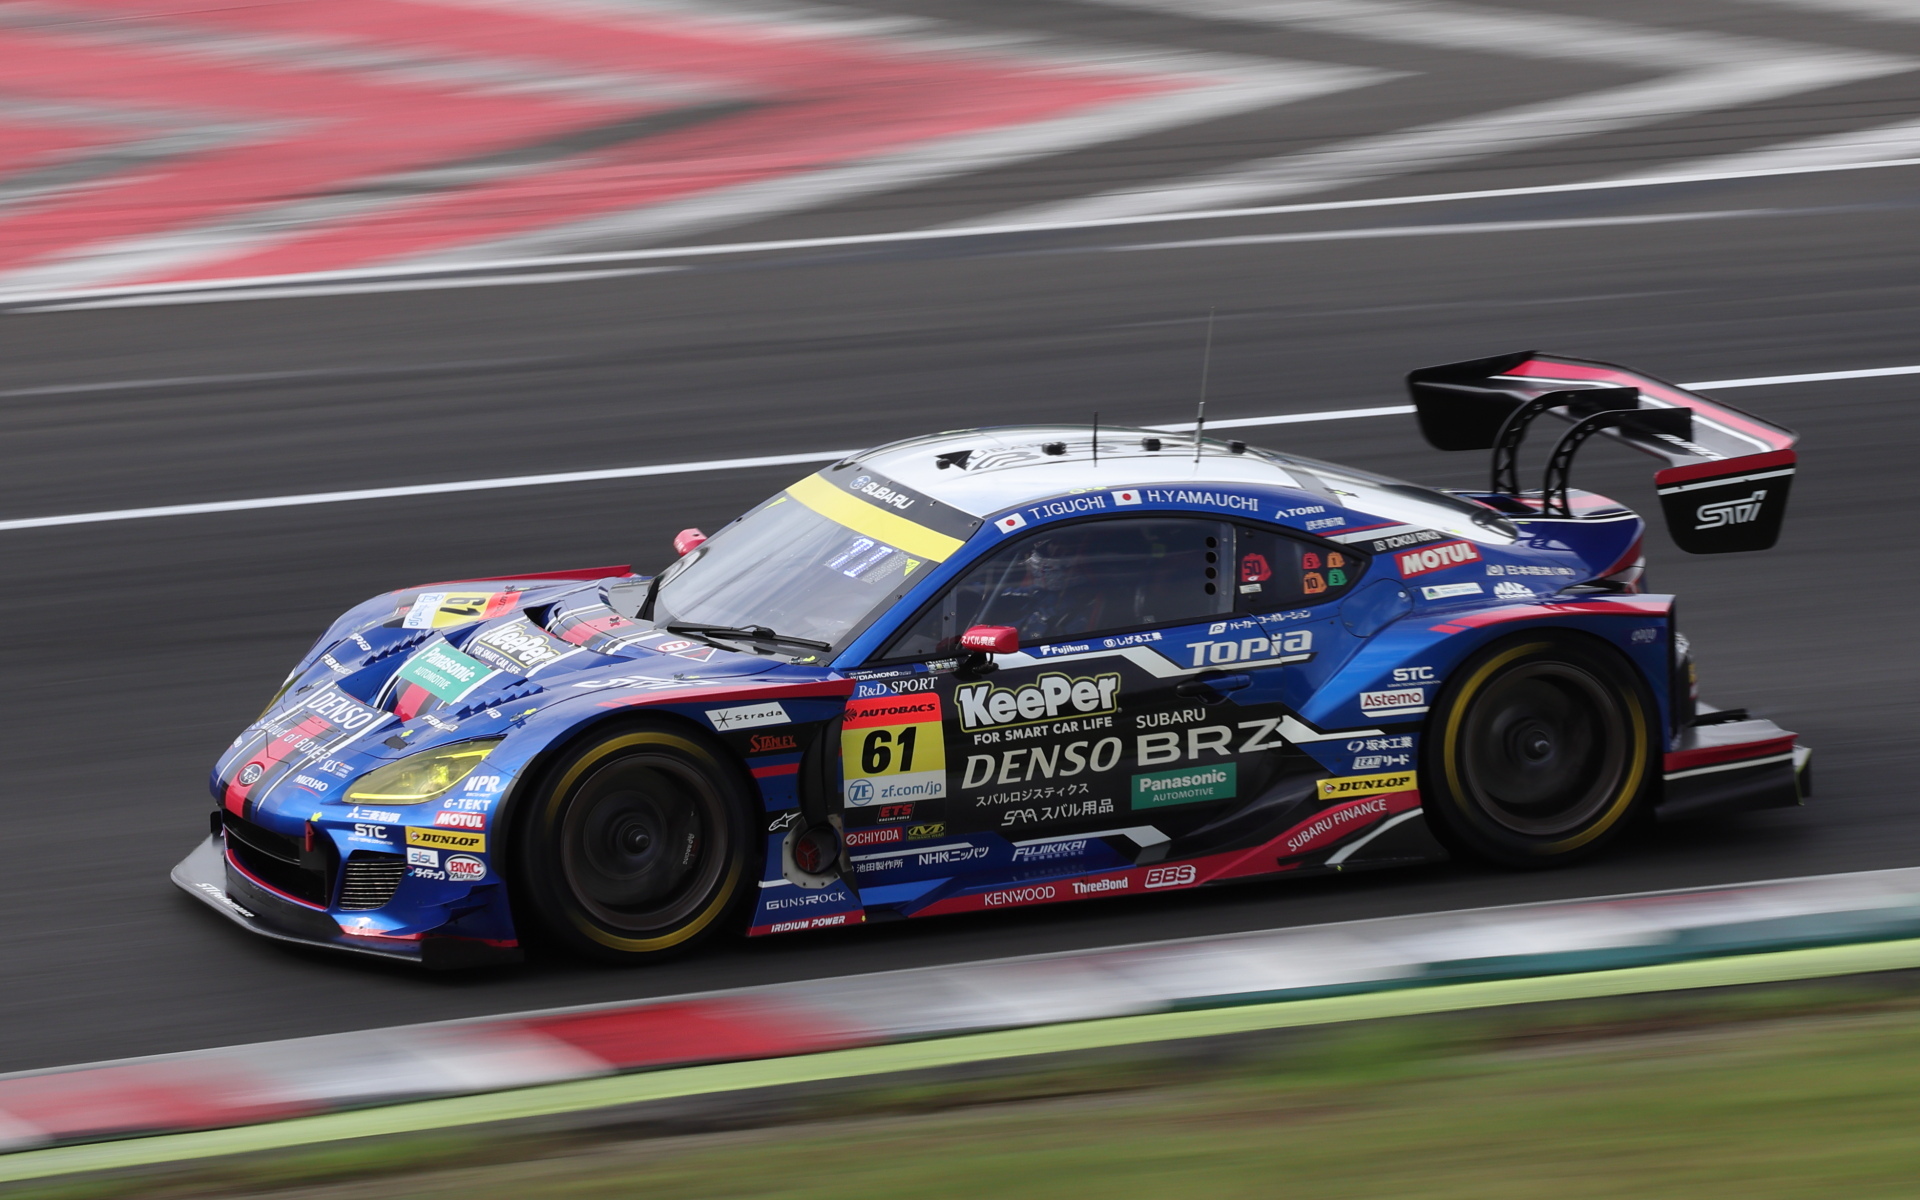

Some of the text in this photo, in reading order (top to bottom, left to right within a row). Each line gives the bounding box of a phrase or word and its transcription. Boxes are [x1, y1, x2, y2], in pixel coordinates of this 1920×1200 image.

[861, 480, 915, 510] SUBARU
[1146, 489, 1260, 512] H.YAMAUCHI
[1028, 495, 1107, 520] T.IGUCHI
[1241, 560, 1261, 576] 50
[1401, 542, 1478, 576] MOTUL
[1305, 577, 1318, 589] 10
[481, 622, 561, 667] KeePer
[1051, 644, 1090, 655] Fujikura
[421, 644, 476, 684] Panasonic
[496, 657, 509, 670] CAR
[413, 666, 452, 690] AUTOMOTIVE
[858, 670, 900, 681] DIAMOND
[1392, 665, 1435, 681] STC
[857, 676, 938, 698] R&D SPORT
[959, 676, 1118, 729] KeePer
[1363, 692, 1422, 707] Astemo
[306, 691, 374, 730] DENSO
[734, 709, 783, 722] Strada
[857, 702, 936, 719] AUTOBACS
[1136, 707, 1207, 729] SUBARU
[973, 717, 1113, 746] FOR SMART CAR LIFE
[283, 733, 302, 744] of
[293, 737, 333, 763] BOXER
[861, 726, 918, 775] 61
[1136, 717, 1283, 767] BRZ
[961, 736, 1124, 790] DENSO
[292, 774, 329, 792] MIZUHO
[463, 775, 501, 792] NPR
[880, 781, 943, 798] zf.com/jp
[1140, 769, 1227, 793] Panasonic
[1337, 776, 1411, 792] DUNLOP
[976, 783, 1089, 807] スバルロジスティクス
[1152, 787, 1214, 803] AUTOMOTIVE
[443, 798, 492, 812] G-TEKT
[880, 803, 913, 818] ETS
[1040, 798, 1114, 821] スバル用品
[435, 811, 485, 828] MOTUL
[1287, 799, 1388, 852] SUBARU FINANCE
[354, 823, 388, 839] STC
[421, 833, 480, 847] DUNLOP
[857, 829, 900, 844] CHIYODA
[449, 860, 481, 875] BMC
[856, 859, 904, 873] 池田製作所
[1072, 877, 1129, 894] ThreeBond
[1144, 864, 1197, 889] BBS
[766, 891, 846, 911] GUNSROCK
[984, 886, 1056, 906] KENWOOD
[771, 915, 846, 933] IRIDIUM POWER
